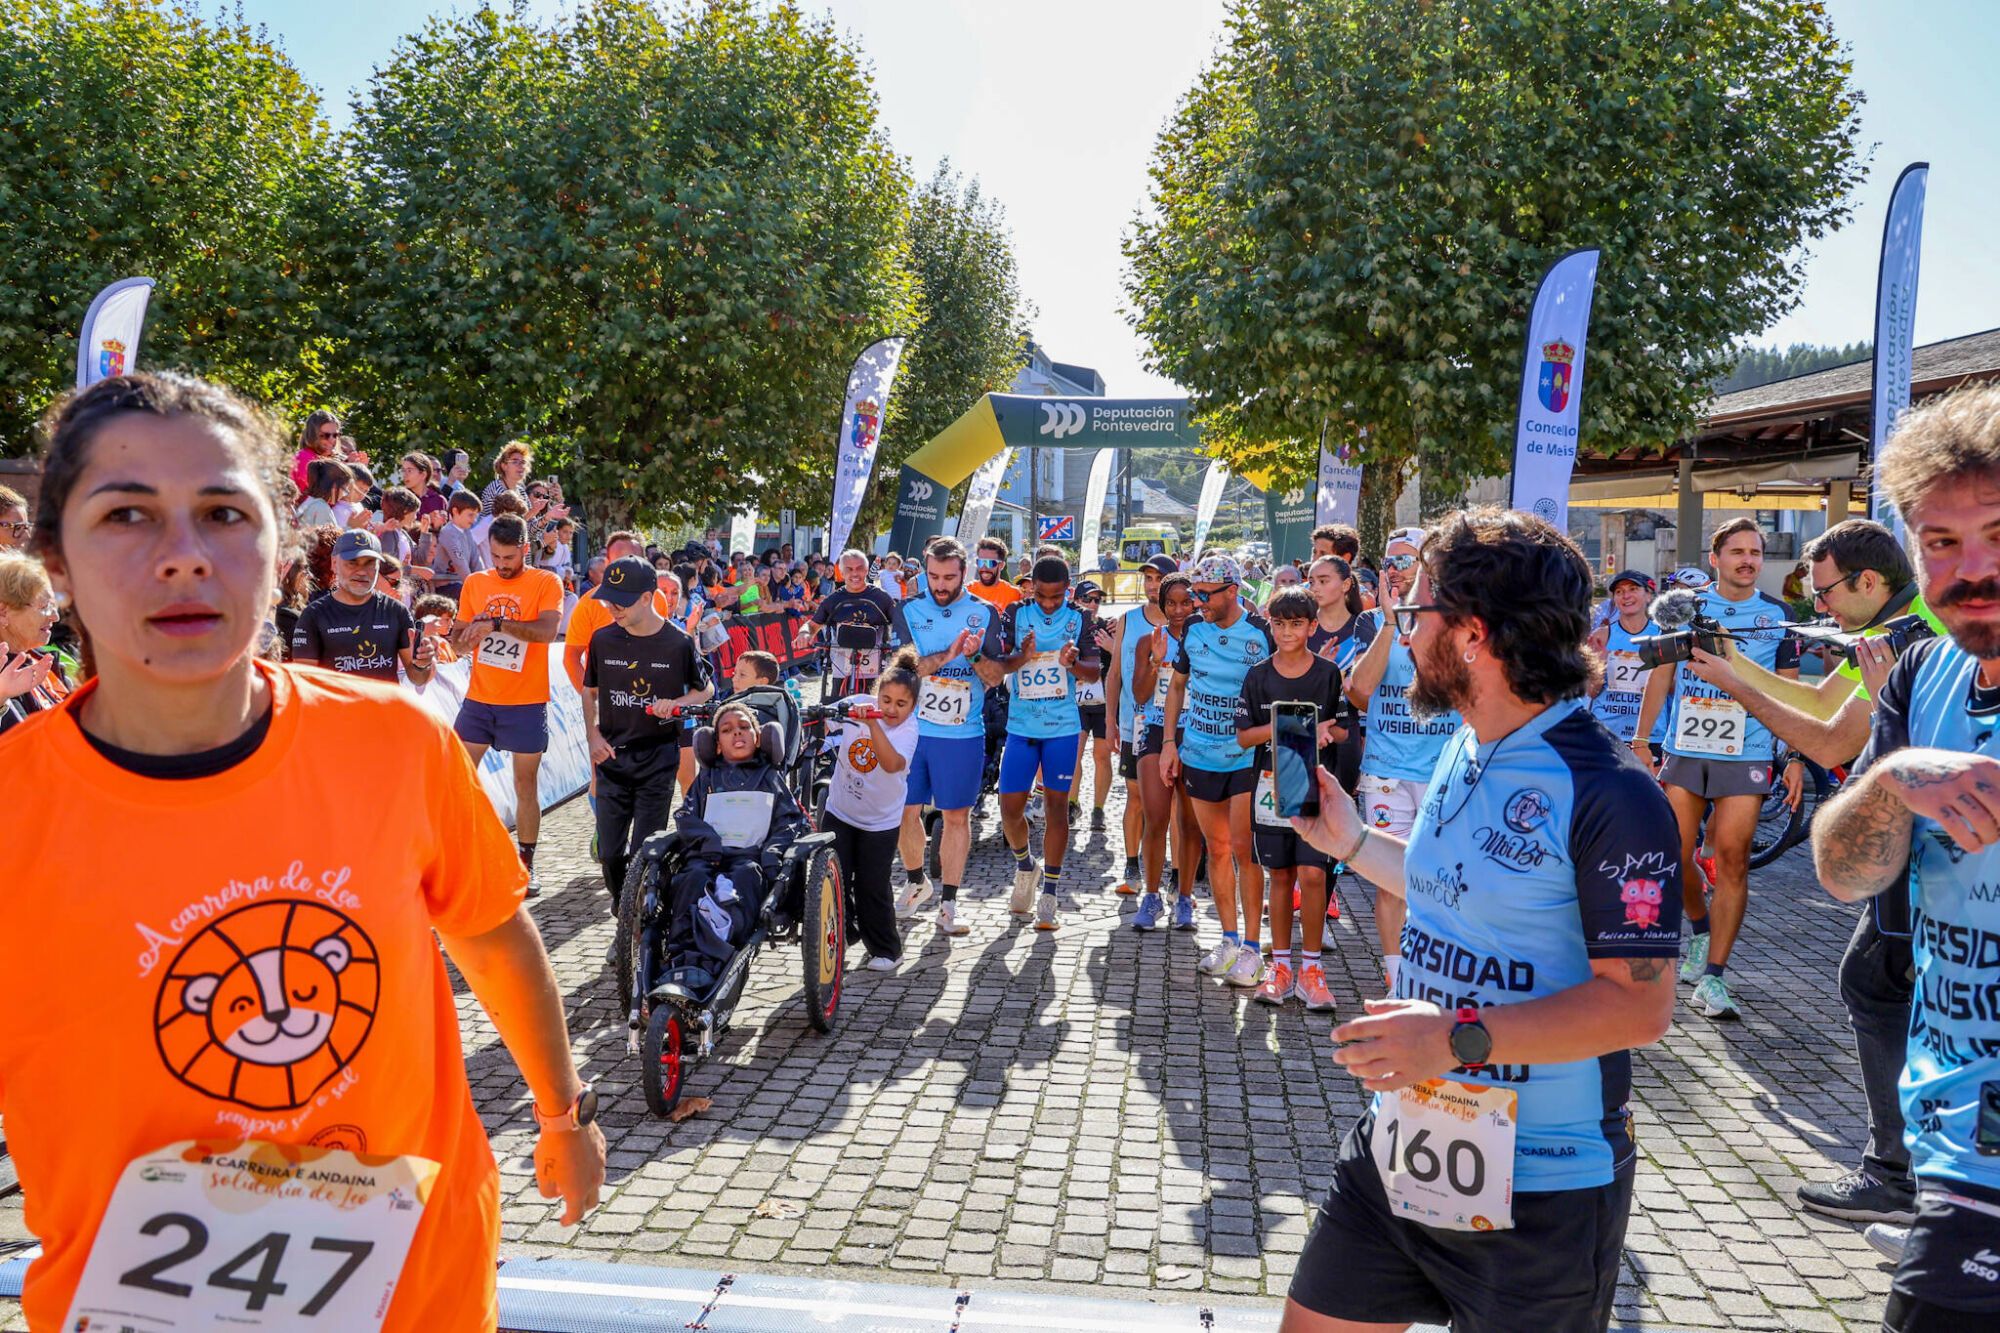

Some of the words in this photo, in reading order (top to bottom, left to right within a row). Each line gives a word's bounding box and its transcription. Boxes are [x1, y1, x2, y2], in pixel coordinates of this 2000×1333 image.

[1898, 287, 1911, 408] ntevedra
[1093, 406, 1174, 421] Deputación
[1093, 419, 1174, 431] Pontevedra
[1526, 420, 1576, 437] Concello
[1527, 440, 1543, 454] de
[1546, 442, 1574, 456] Meis
[1337, 480, 1358, 491] Meis
[898, 509, 937, 520] Pontevedra
[900, 502, 938, 514] Deputación
[1275, 507, 1314, 518] Deputación
[327, 626, 352, 634] IBERIA
[482, 637, 520, 659] 224
[334, 654, 393, 672] SONRISAS
[1021, 667, 1061, 687] 563
[610, 694, 657, 708] SONRISA
[1606, 692, 1642, 703] INCLUS
[1682, 685, 1733, 701] INCLUS
[925, 692, 963, 715] 261
[1189, 718, 1238, 736] VISIBILID
[1377, 719, 1455, 736] VISIBILIDAD
[1682, 716, 1736, 740] 292
[1599, 852, 1678, 881] SAMA
[1436, 867, 1464, 892] SAN
[169, 875, 274, 933] carreira
[278, 860, 314, 892] de
[315, 866, 362, 910] Leo
[1439, 1092, 1480, 1108] ANDAINA
[1387, 1118, 1485, 1197] 160
[1521, 1146, 1578, 1158] CAPILAR
[216, 1156, 290, 1178] CARREIRA
[296, 1168, 304, 1179] E
[308, 1168, 376, 1188] ANDAINA
[210, 1171, 303, 1199] solidaria
[309, 1185, 334, 1201] de
[337, 1189, 369, 1213] Leo
[118, 1211, 375, 1317] 247
[1961, 1258, 1999, 1283] ipso
